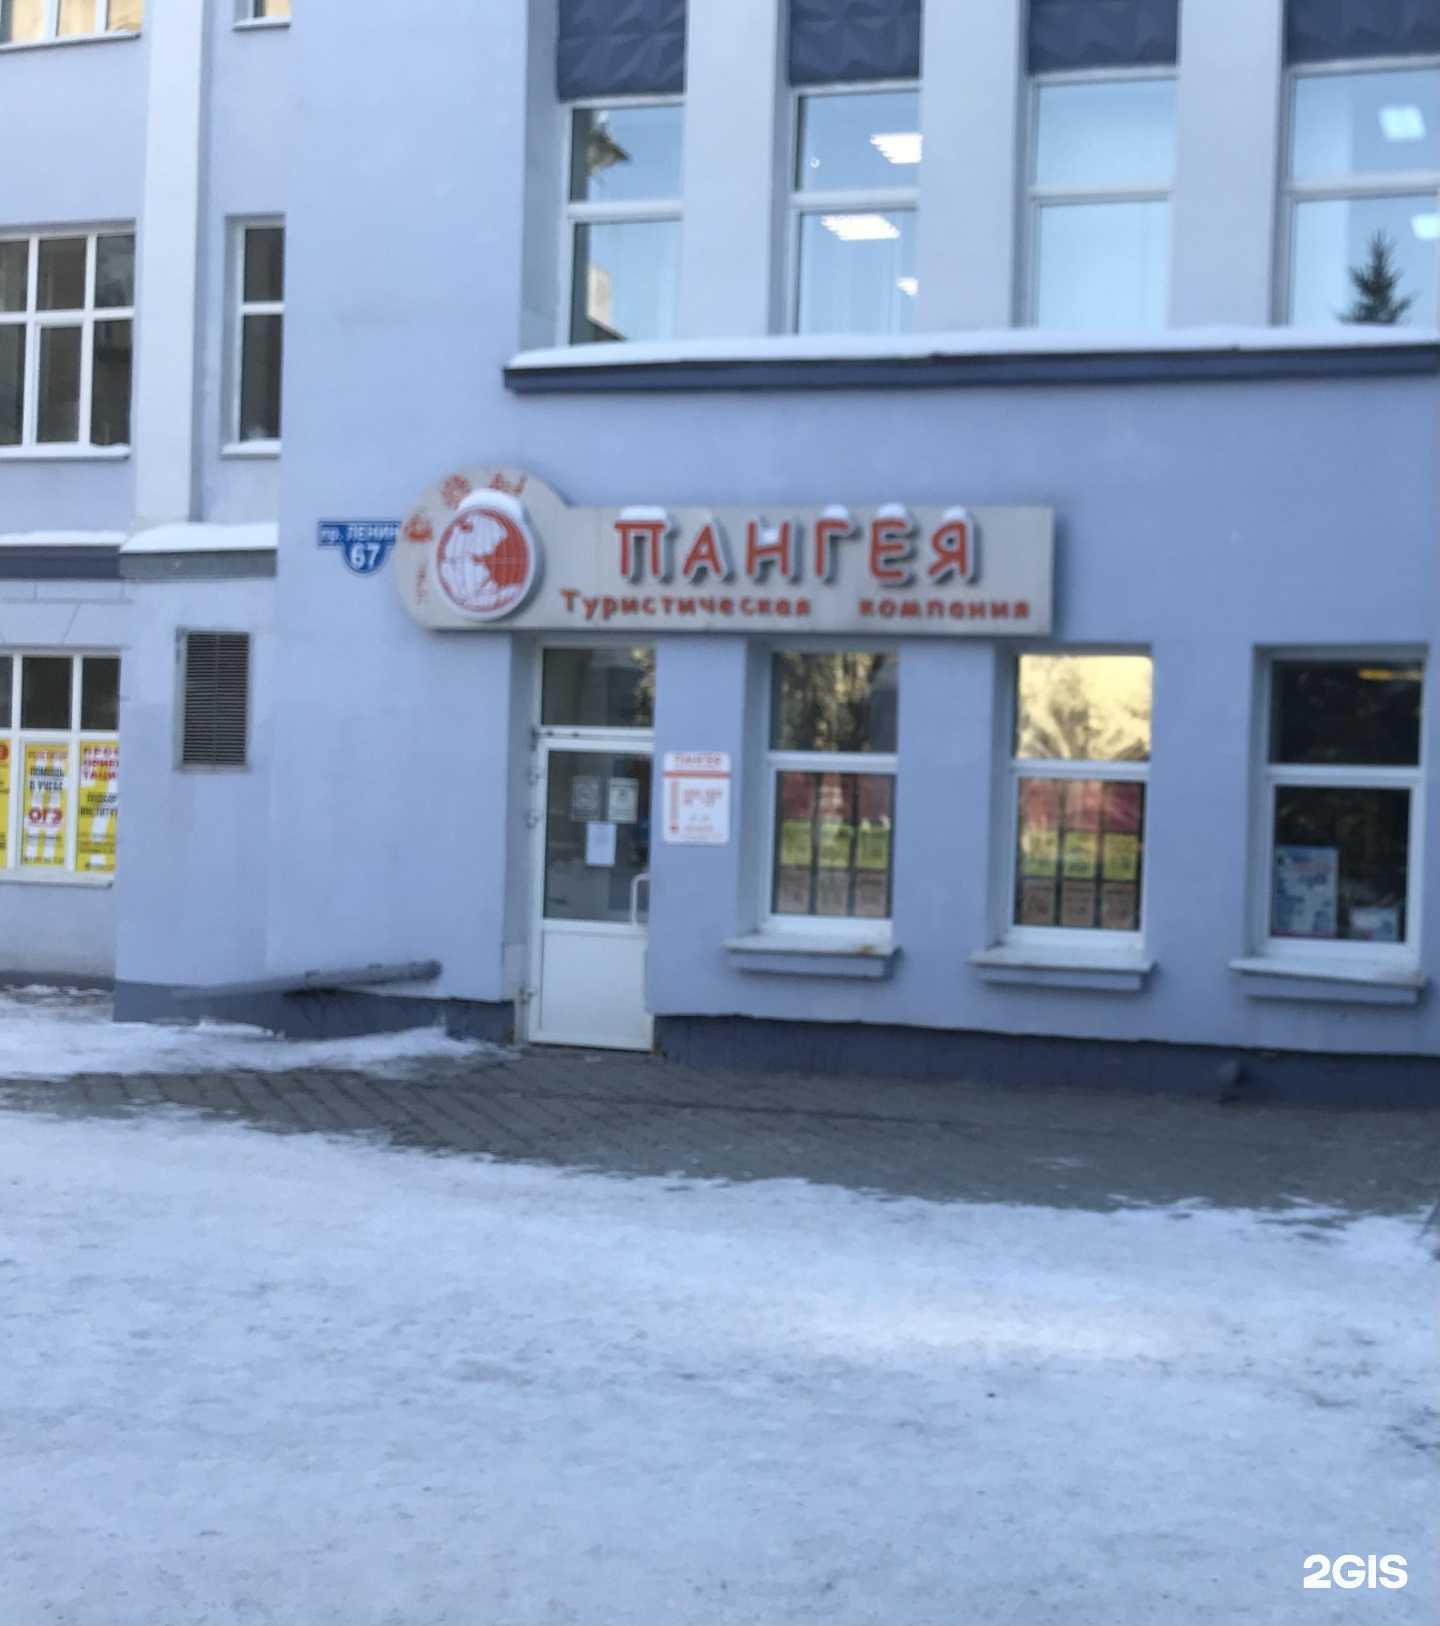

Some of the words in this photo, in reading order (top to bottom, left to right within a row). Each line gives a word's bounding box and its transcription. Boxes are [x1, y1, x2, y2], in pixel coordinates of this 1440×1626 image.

[347, 525, 399, 542] ЛЕНИН
[350, 543, 381, 570] 67
[614, 517, 967, 578] ПАНГЕЯ
[560, 588, 812, 620] Туристическая
[858, 597, 1030, 619] компания
[28, 806, 63, 825] ОГЭ
